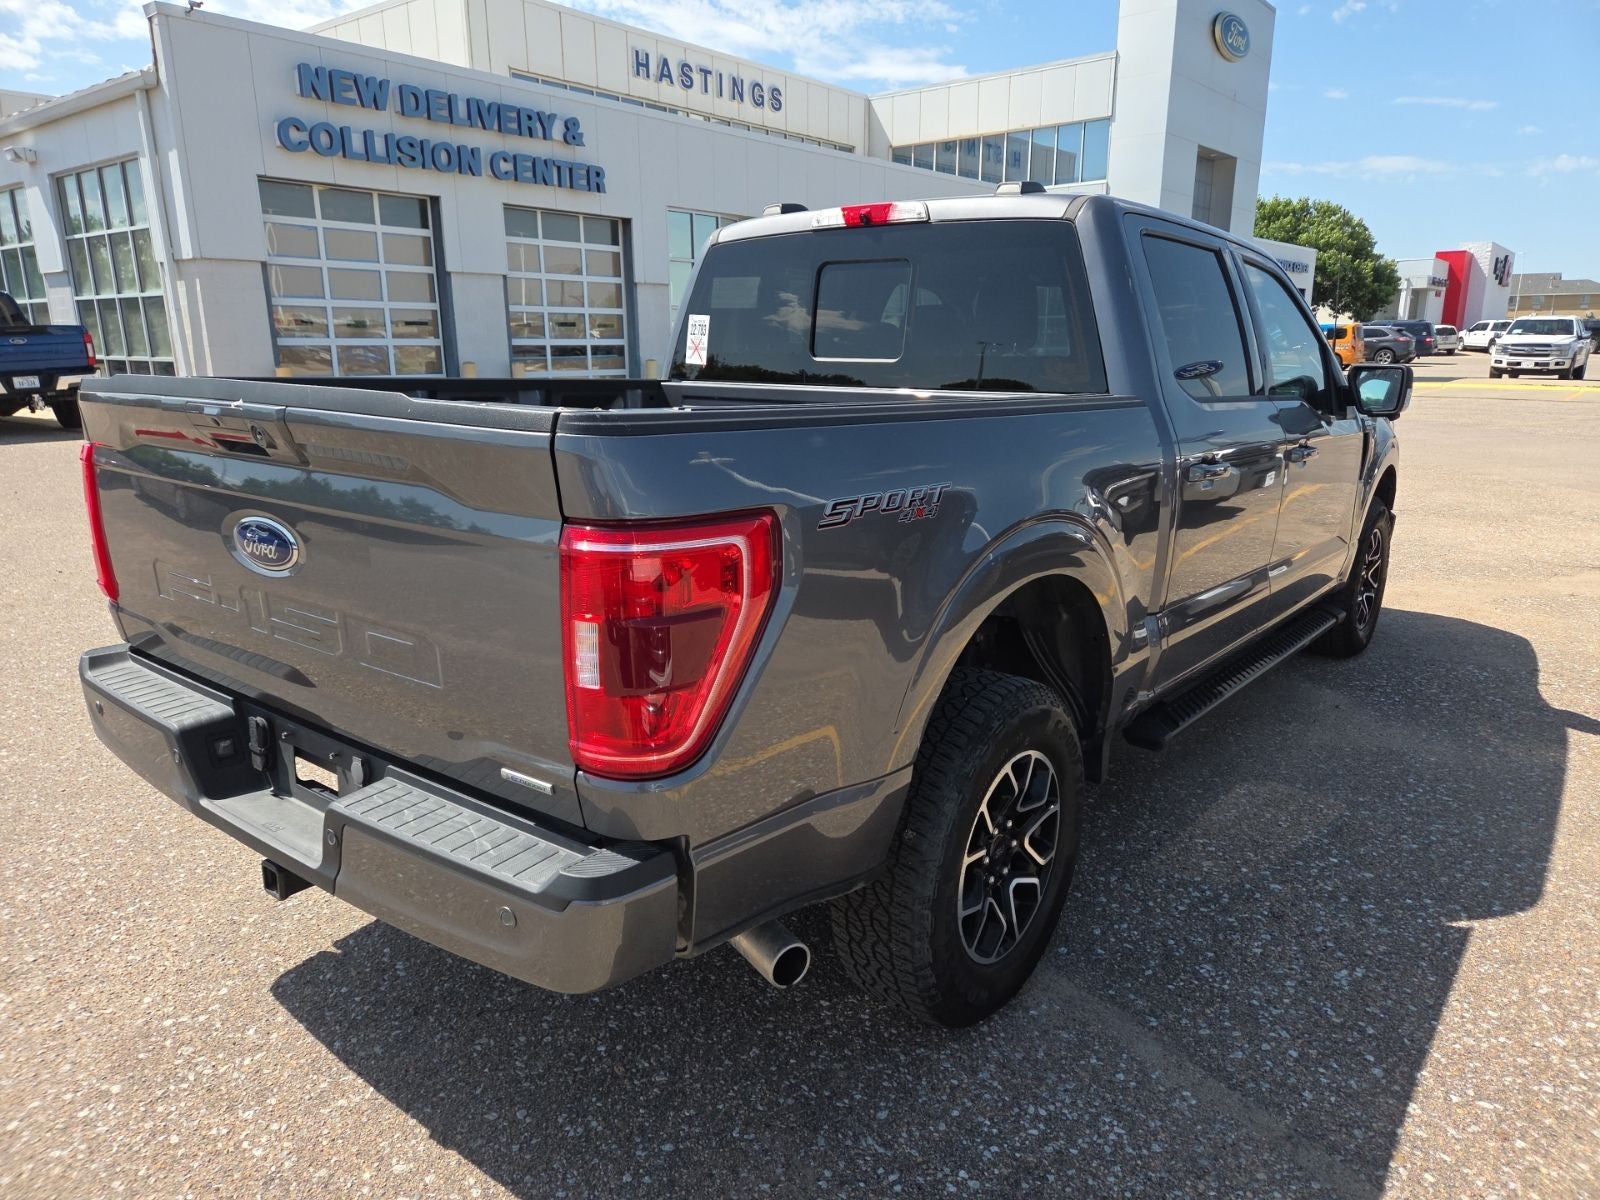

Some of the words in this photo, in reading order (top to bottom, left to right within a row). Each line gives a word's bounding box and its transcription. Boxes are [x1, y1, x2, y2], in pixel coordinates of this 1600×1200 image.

[296, 63, 390, 111] NEW
[396, 84, 557, 141] DELIVERY
[562, 116, 586, 147] &
[633, 49, 783, 112] HASTINGS
[276, 116, 483, 177] COLLISION
[490, 150, 607, 193] CENTER
[817, 481, 952, 531] SPORT
[243, 526, 279, 560] Ford
